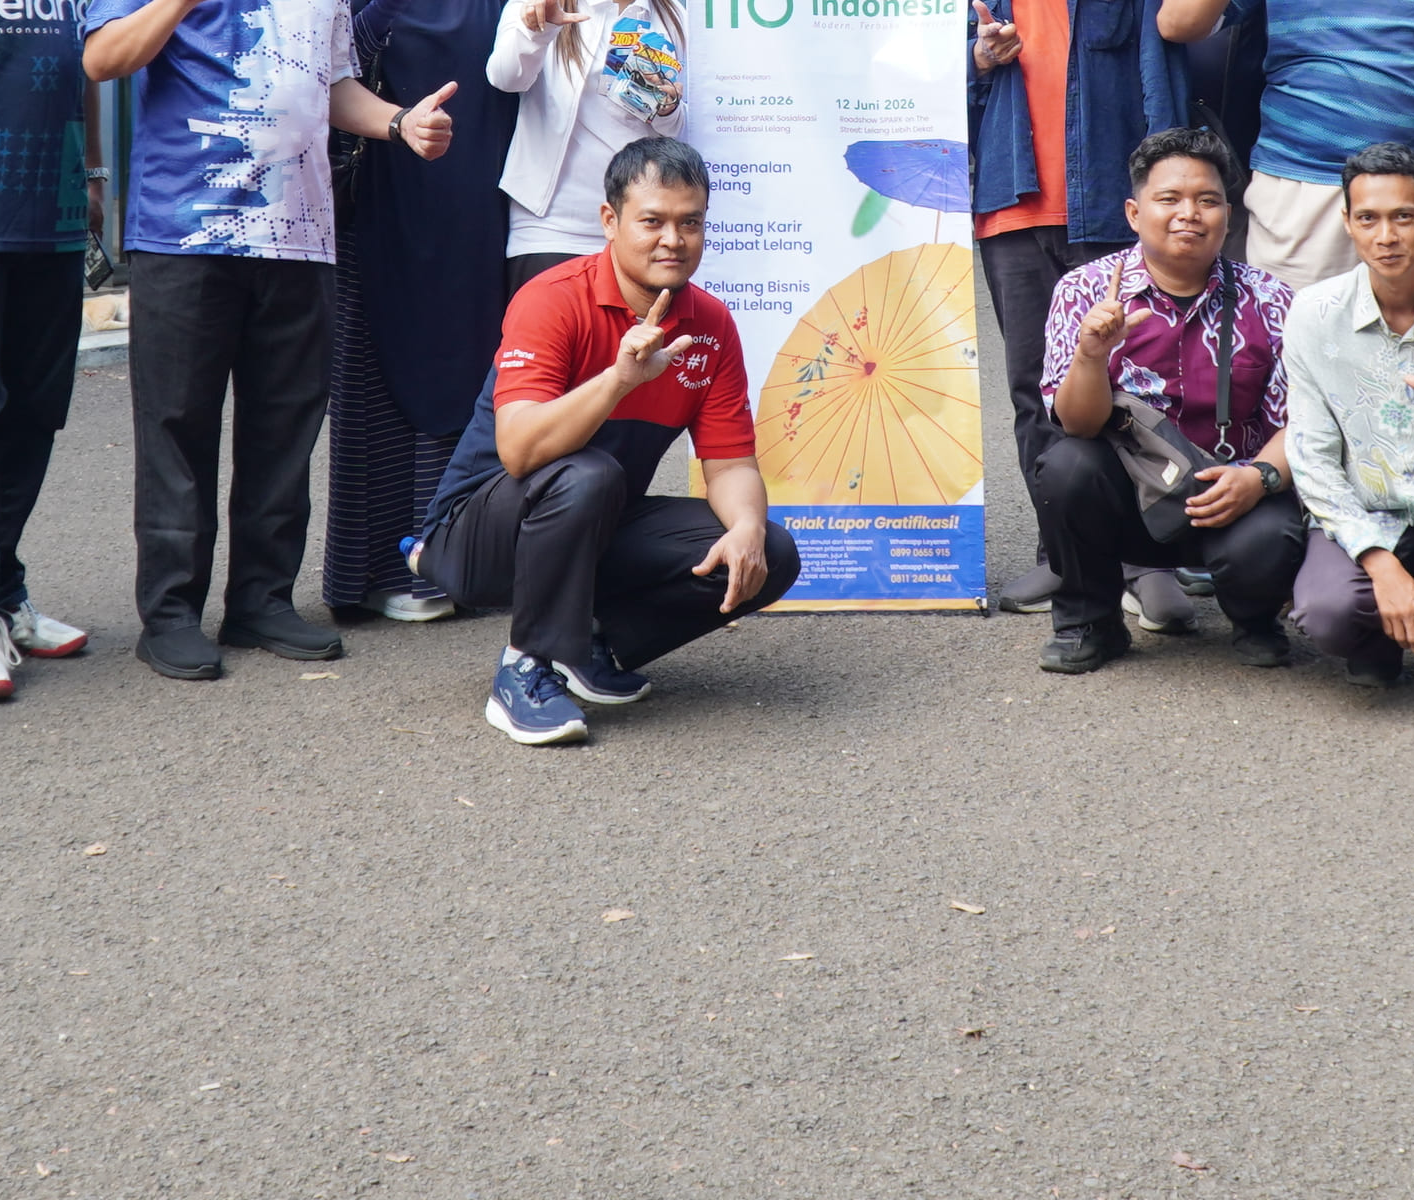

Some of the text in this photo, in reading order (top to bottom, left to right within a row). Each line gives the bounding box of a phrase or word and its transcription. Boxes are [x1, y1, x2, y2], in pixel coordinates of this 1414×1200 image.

[715, 96, 793, 105] 9 Juni 2026
[836, 99, 915, 110] 12 Juni 2026
[777, 114, 817, 122] Sosialisasi
[716, 125, 791, 135] dan Edukasi Lelang
[703, 161, 792, 177] Pengenalan
[709, 179, 751, 195] elang
[704, 220, 803, 237] Peluang Karir
[704, 238, 813, 255] Pejabat Lelang
[704, 280, 811, 297] Peluang Bisnis
[743, 298, 793, 314] Lelang
[691, 334, 721, 351] orld's
[687, 353, 708, 372] #1
[676, 371, 711, 390] Monitor
[784, 516, 960, 533] Tolak Lapor Gratifikasi!
[935, 548, 951, 557] 915
